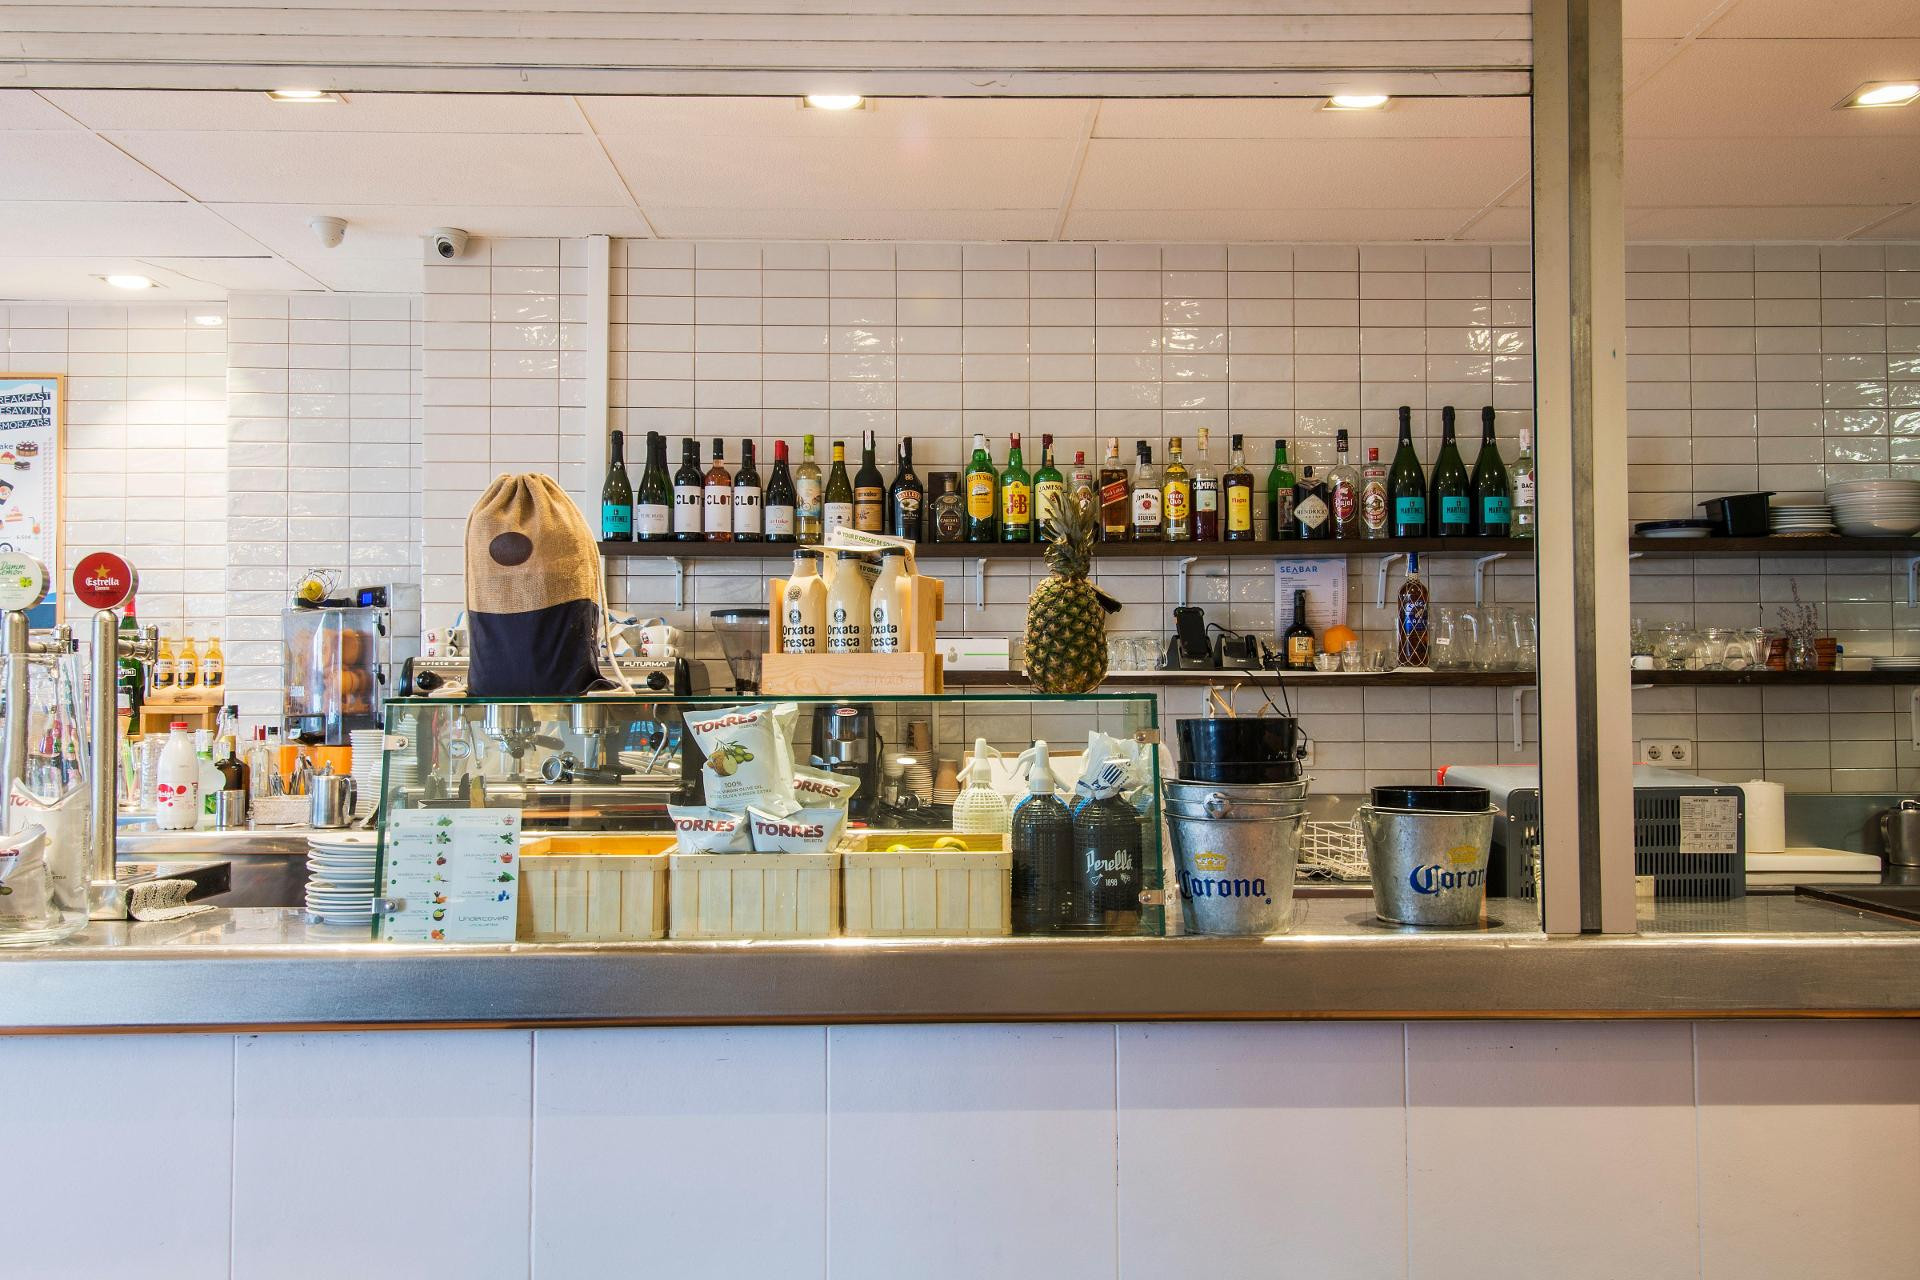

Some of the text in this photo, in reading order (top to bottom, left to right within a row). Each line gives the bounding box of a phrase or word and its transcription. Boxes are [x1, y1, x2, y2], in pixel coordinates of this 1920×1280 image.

[0, 391, 50, 404] REAKFAST
[0, 407, 49, 415] ESAYUNO
[0, 418, 50, 430] SMORZARS
[0, 442, 14, 450] ake
[1192, 481, 1217, 490] CAMPAR
[676, 495, 700, 505] CLOT
[707, 495, 731, 505] CLOT
[735, 496, 759, 506] CLOT
[85, 576, 120, 587] Estrella
[783, 625, 815, 636] Orxata
[828, 624, 860, 635] Orxata
[828, 636, 860, 648] Fresca
[871, 636, 898, 647] resca
[693, 712, 758, 735] TORRES
[793, 779, 841, 798] ORRES
[674, 818, 735, 833] TORRES
[755, 821, 824, 838] TORRES
[1409, 864, 1484, 897] Coron
[1178, 870, 1265, 903] Corona
